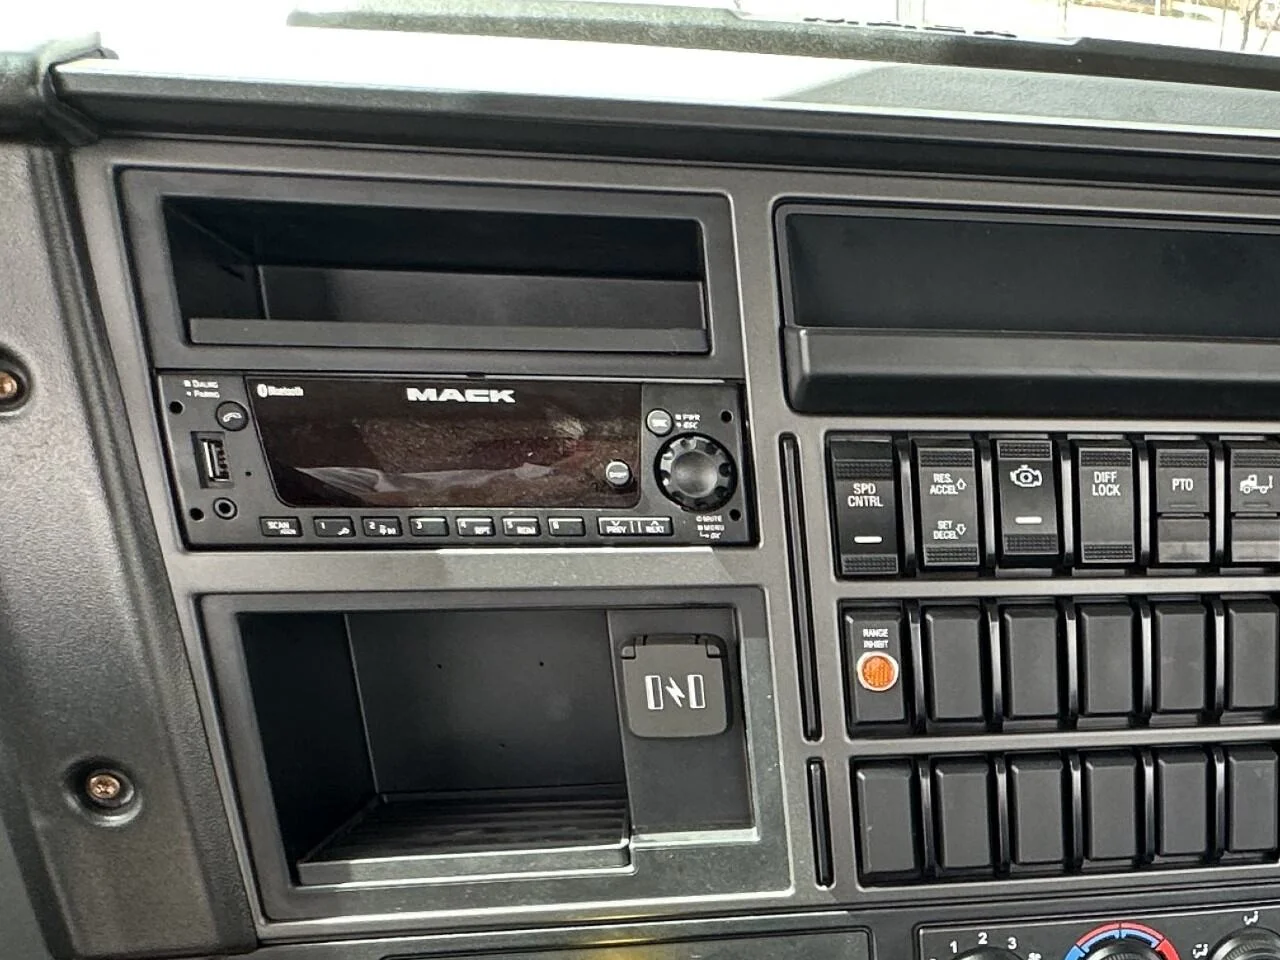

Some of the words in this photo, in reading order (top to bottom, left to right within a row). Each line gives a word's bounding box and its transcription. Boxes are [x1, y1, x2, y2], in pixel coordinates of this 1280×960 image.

[406, 387, 516, 403] MACK
[1094, 471, 1118, 484] DIFF
[852, 482, 877, 495] SPD
[929, 485, 959, 495] ACCEL
[1092, 483, 1122, 497] LOCK
[1172, 477, 1194, 492] PTO
[847, 494, 884, 508] CNTRL
[937, 520, 953, 530] SET
[933, 529, 959, 540] DECEL
[978, 932, 988, 945] 2
[1007, 937, 1018, 950] 3
[949, 940, 958, 953] 1
